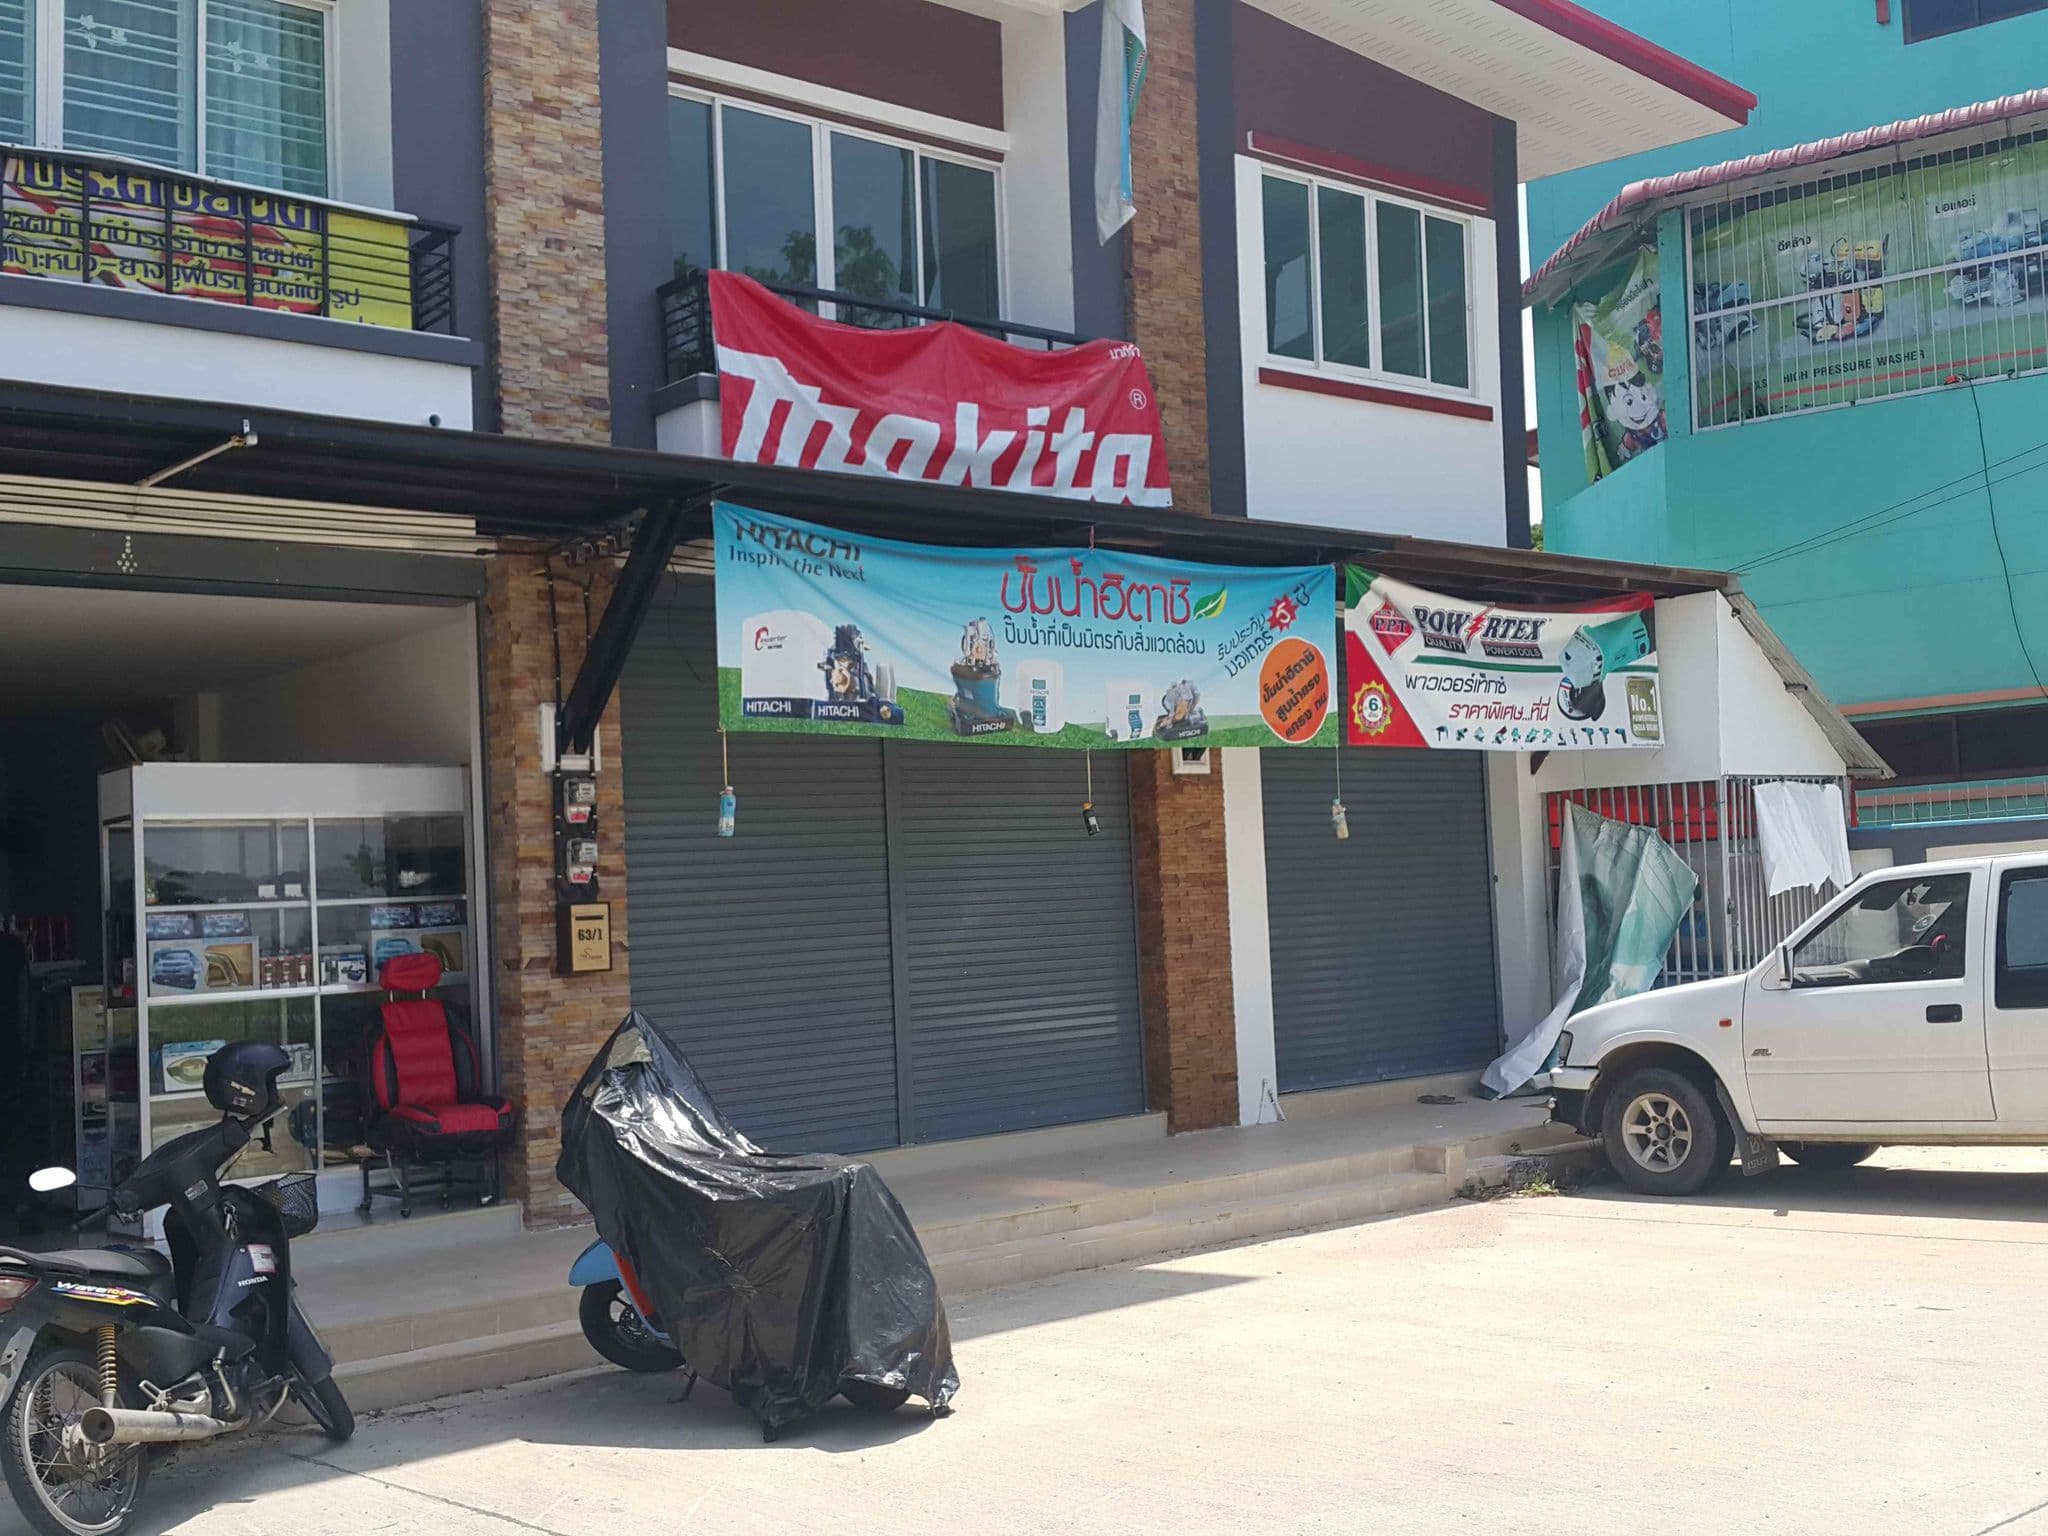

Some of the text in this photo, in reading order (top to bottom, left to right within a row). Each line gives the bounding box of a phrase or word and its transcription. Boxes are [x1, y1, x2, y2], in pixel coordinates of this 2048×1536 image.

[1813, 358, 1872, 378] PRESSURE
[1877, 350, 1925, 367] WASHER
[735, 518, 861, 561] HITACHI
[793, 558, 823, 577] the
[829, 563, 865, 583] Next
[1374, 617, 1409, 634] PPT
[1425, 636, 1542, 659] QUALITY POWERTOOLS
[746, 701, 792, 713] HITACHI
[1368, 697, 1379, 712] 6
[1630, 686, 1657, 712] No.1
[818, 704, 860, 717] HITACHI
[972, 721, 1006, 732] HITACHI
[577, 924, 603, 941] 63/1
[237, 1275, 269, 1288] HONDA
